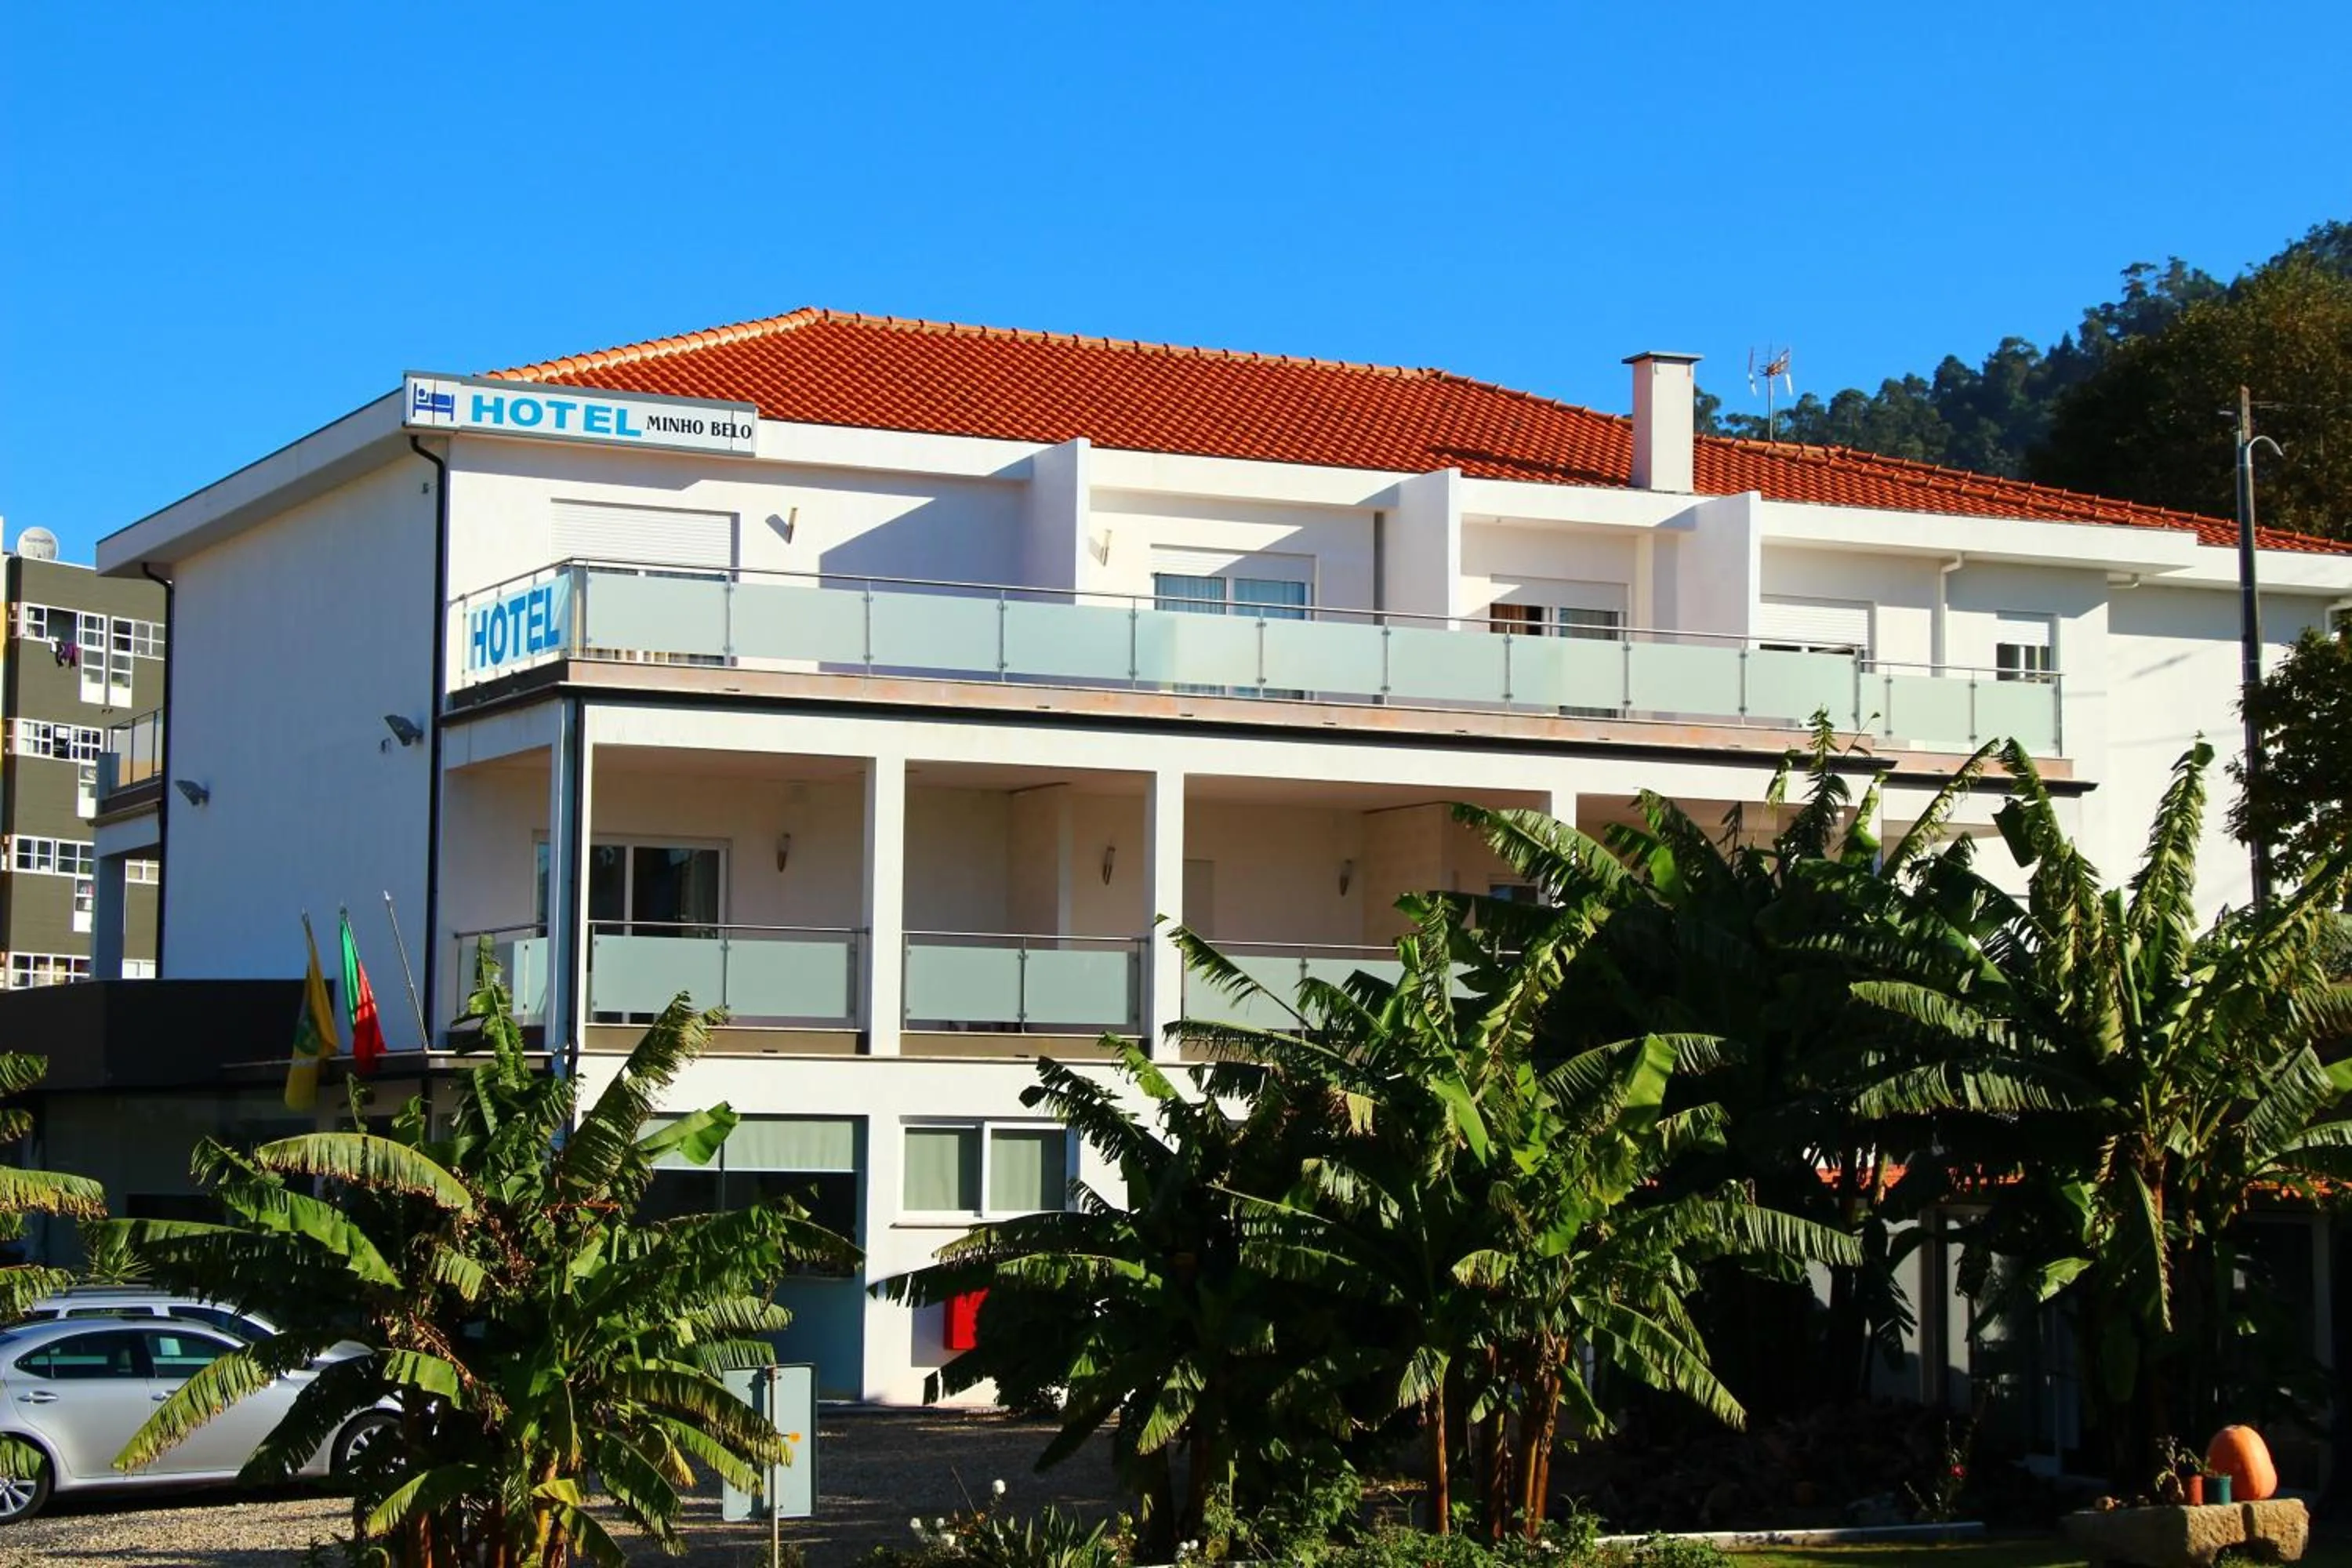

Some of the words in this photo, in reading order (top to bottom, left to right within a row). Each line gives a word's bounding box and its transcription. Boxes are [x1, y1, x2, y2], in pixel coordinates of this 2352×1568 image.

[471, 394, 642, 437] HOTEL
[646, 415, 704, 435] MINHO
[710, 421, 753, 440] BELO
[469, 586, 560, 671] HOTEL
